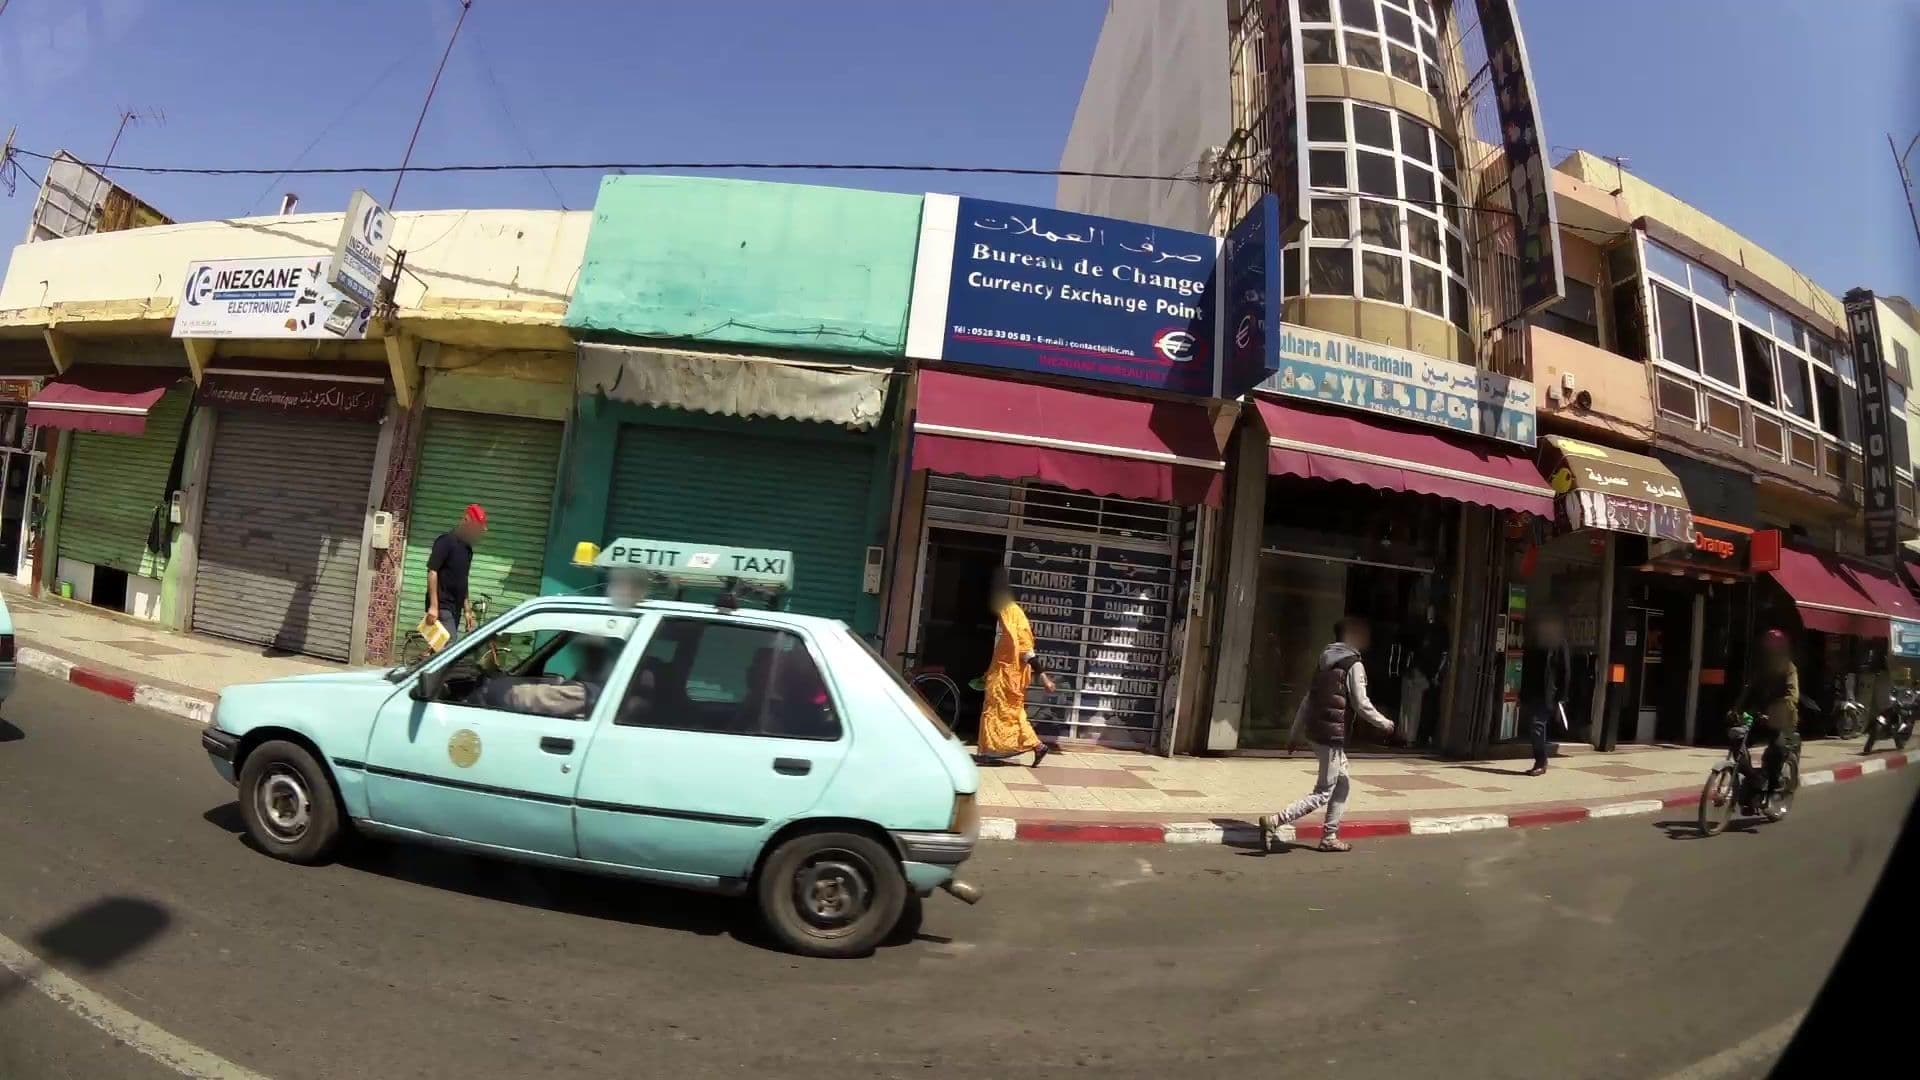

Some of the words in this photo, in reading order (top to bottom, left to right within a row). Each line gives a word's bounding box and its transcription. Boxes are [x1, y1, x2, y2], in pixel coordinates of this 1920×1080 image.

[973, 215, 1106, 247] العملات
[348, 235, 383, 266] INEZGANE
[1120, 229, 1202, 264] صرف
[215, 268, 303, 290] INEZGANE
[971, 242, 1064, 272] Bureau
[1073, 258, 1104, 278] de
[1112, 264, 1205, 295] Change
[227, 301, 291, 314] ELECTRONIQUE
[968, 271, 1054, 300] Currency
[1060, 284, 1149, 313] Exchange
[1156, 299, 1204, 321] Point
[971, 327, 993, 337] 0528
[994, 329, 1006, 339] 33
[1007, 331, 1019, 341] 05
[1037, 335, 1064, 347] E-mail
[1326, 340, 1341, 362] Al
[1345, 344, 1413, 378] Haramain
[1853, 311, 1887, 488] HILTON
[1695, 531, 1736, 559] Orange
[611, 546, 680, 567] PETIT
[731, 555, 786, 575] TAXI
[1021, 570, 1077, 590] CHANGE
[1020, 592, 1073, 617] CAMBIO
[1103, 600, 1155, 624] BUREAU
[1090, 626, 1105, 643] DE
[1106, 630, 1160, 648] CHANGE
[1088, 648, 1160, 671] CURRENCY
